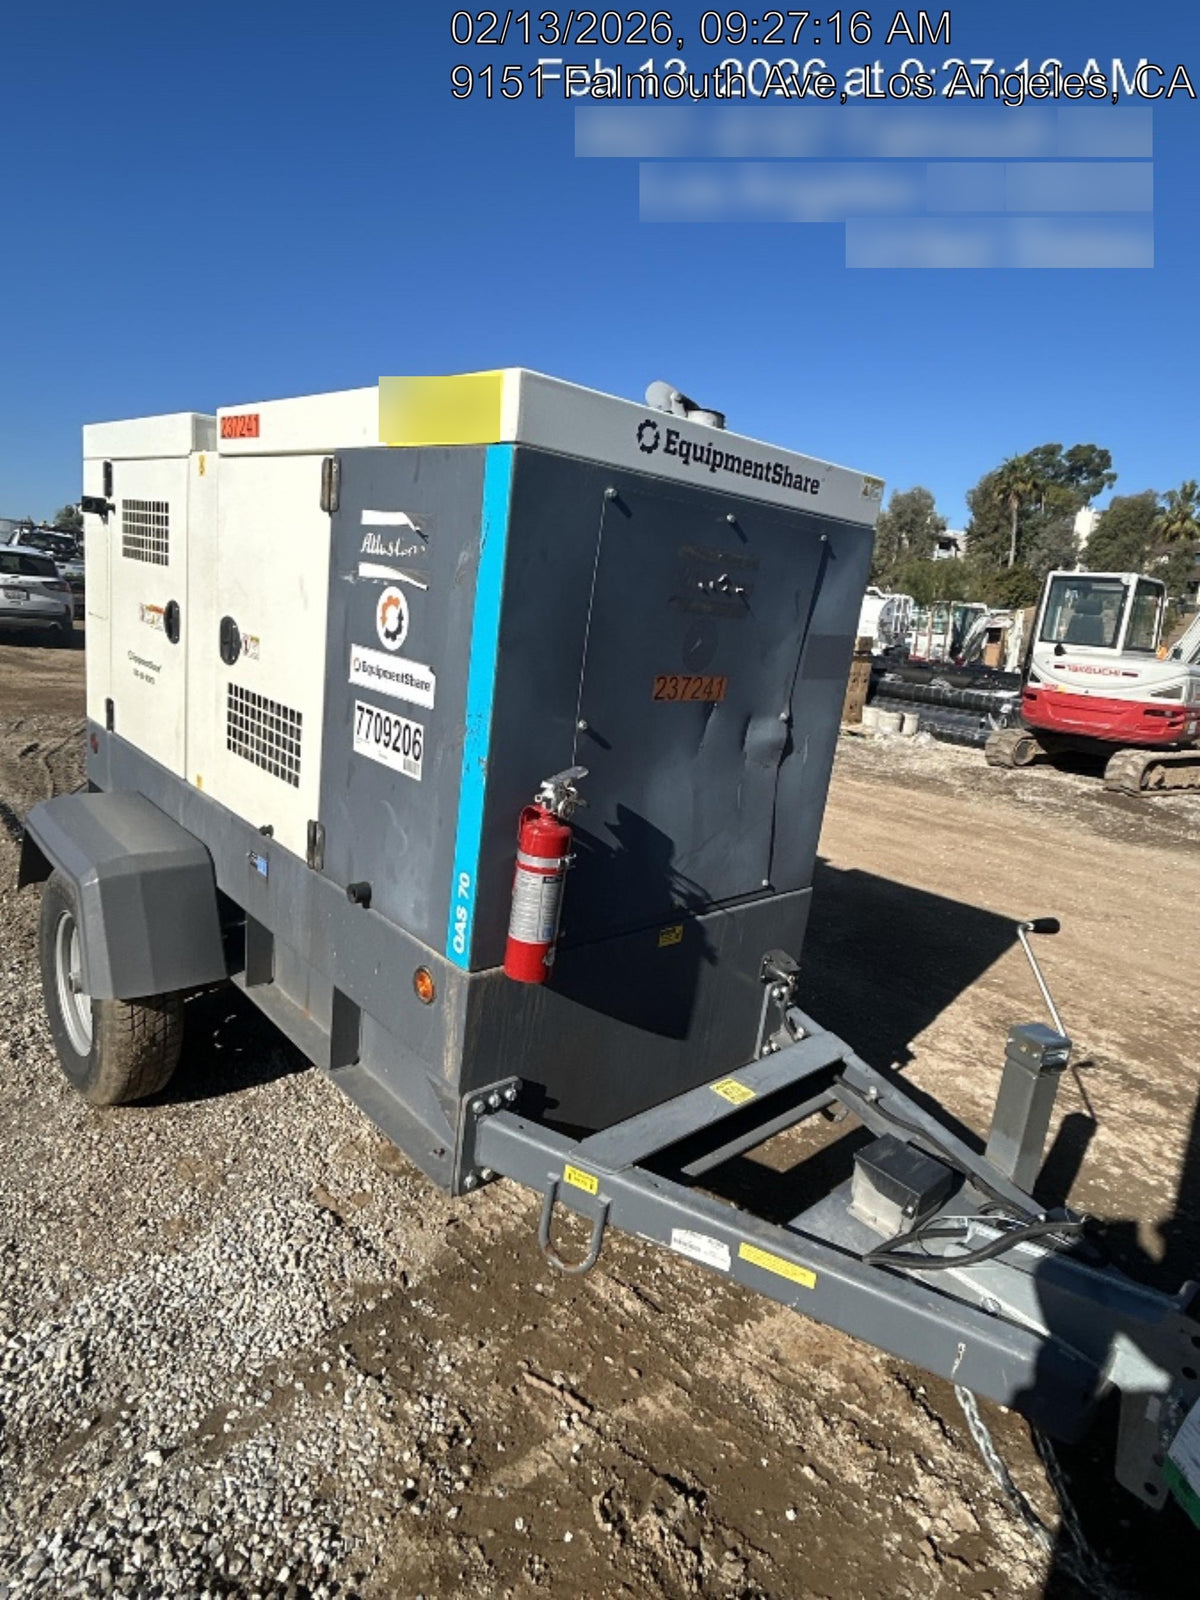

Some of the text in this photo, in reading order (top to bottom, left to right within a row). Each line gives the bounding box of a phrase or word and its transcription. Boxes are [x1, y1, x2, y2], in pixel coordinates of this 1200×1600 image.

[220, 414, 260, 439] 237241
[664, 427, 821, 495] EquipmentShare
[361, 660, 431, 692] EquipmentShare
[654, 675, 726, 701] 237241
[356, 705, 422, 762] 7709206
[452, 871, 471, 955] QAS 70
